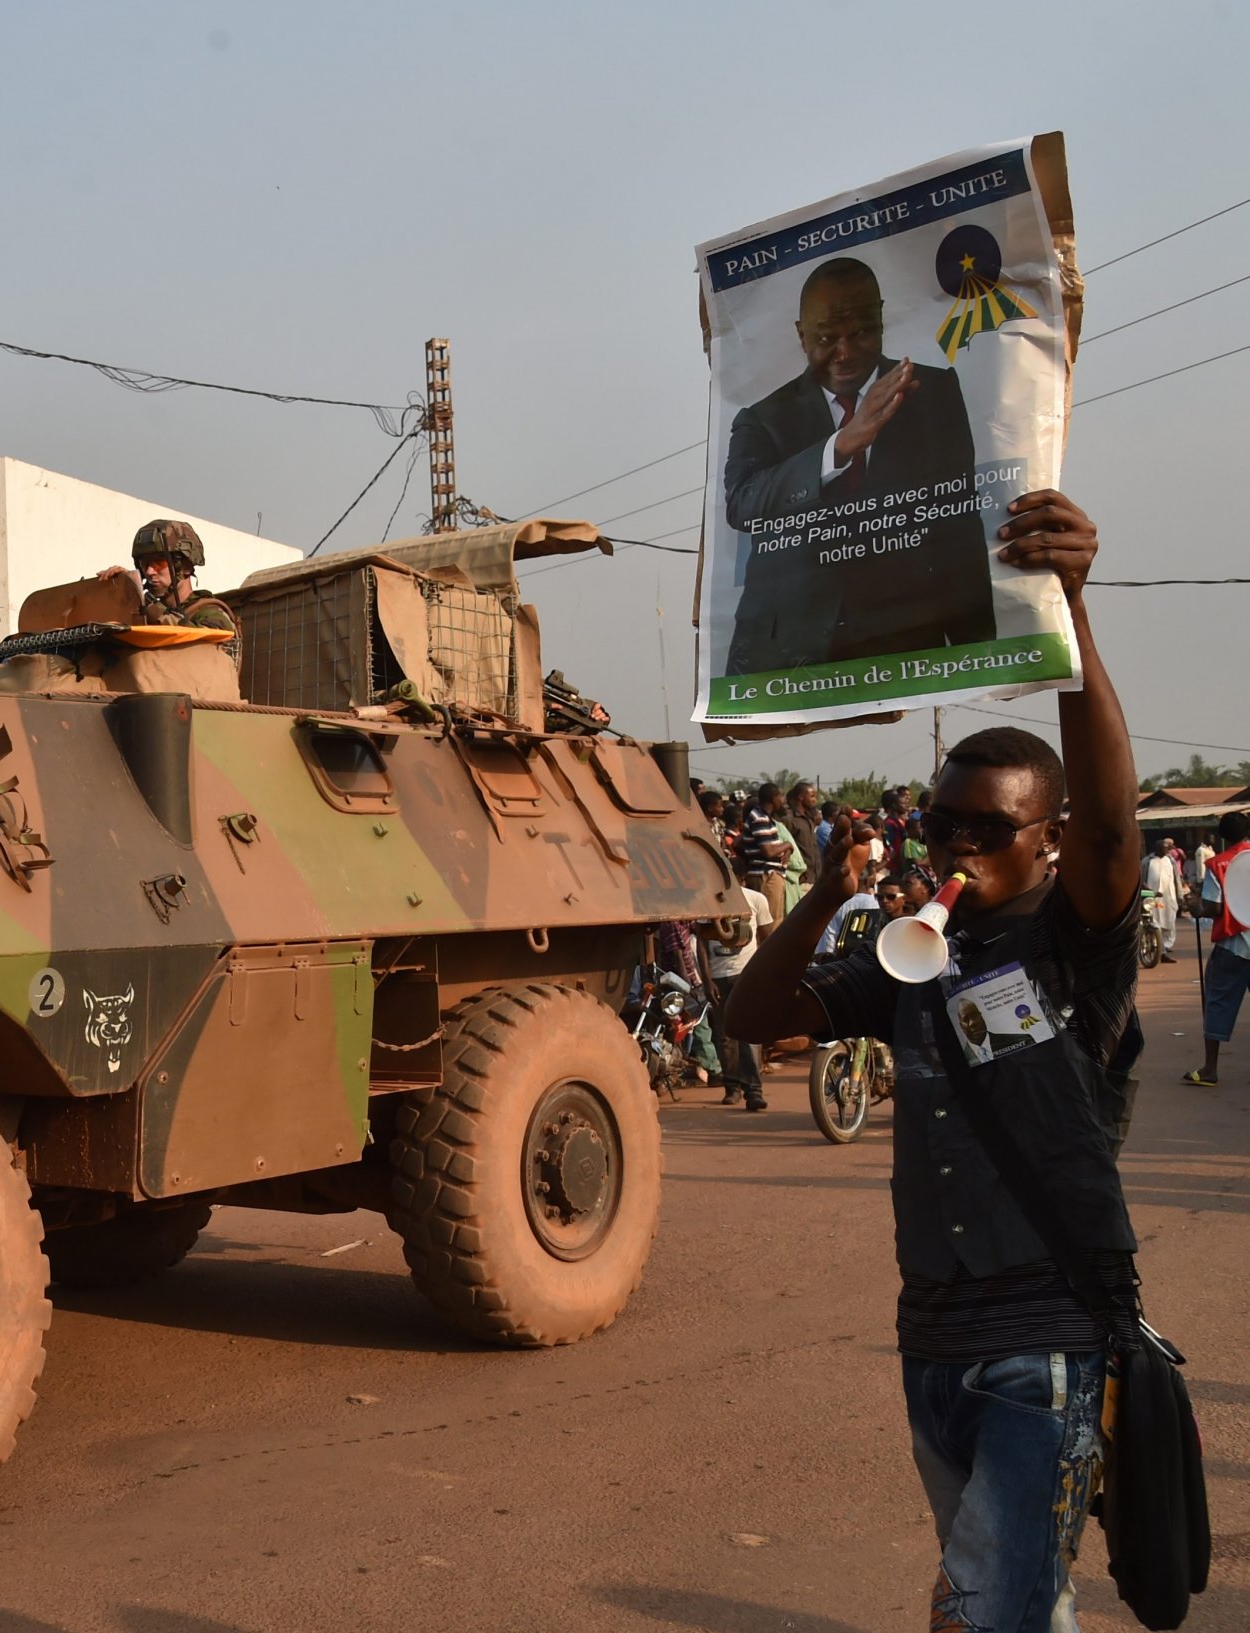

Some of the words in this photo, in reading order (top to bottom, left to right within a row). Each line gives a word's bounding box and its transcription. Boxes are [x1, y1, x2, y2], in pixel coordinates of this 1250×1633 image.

[725, 246, 779, 277] PAIN
[797, 201, 910, 252] SECURITE
[928, 169, 1007, 208] UNITE
[743, 497, 877, 536] "Engagez-vous
[883, 486, 929, 508] avec
[934, 472, 967, 497] moi
[973, 466, 1021, 492] pour
[757, 534, 802, 554] notre
[807, 523, 852, 544] Pain,
[859, 513, 907, 534] notre
[913, 491, 999, 523] Sécurité,
[819, 543, 866, 565] notre
[872, 527, 929, 554] Unité"
[728, 683, 758, 701] Le
[765, 670, 856, 697] Chemin
[863, 664, 893, 685] de
[901, 649, 1043, 681] l'Espérance
[39, 974, 54, 1011] 2
